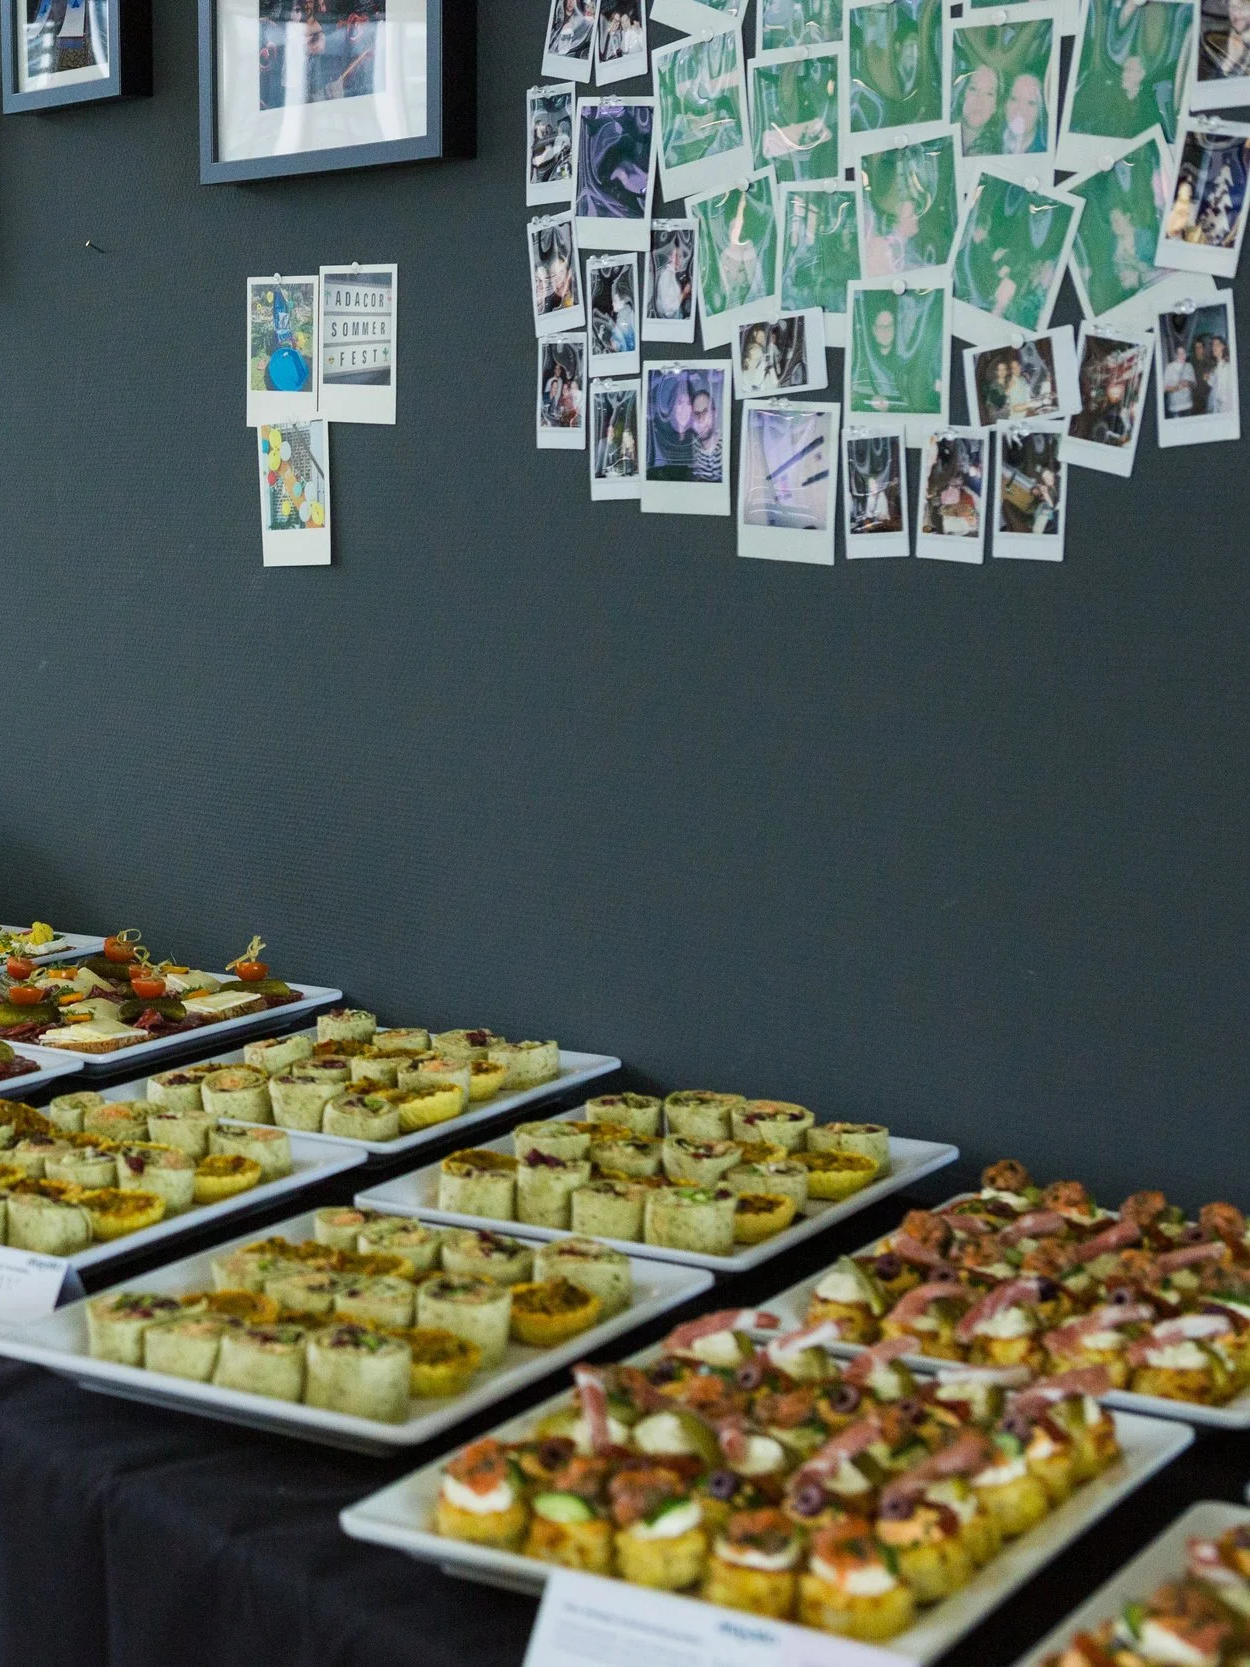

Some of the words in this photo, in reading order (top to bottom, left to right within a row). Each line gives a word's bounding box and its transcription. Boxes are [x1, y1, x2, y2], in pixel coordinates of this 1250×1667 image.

[335, 290, 384, 308] ADACOR
[331, 321, 386, 337] SOMMER
[339, 349, 378, 366] FEST
